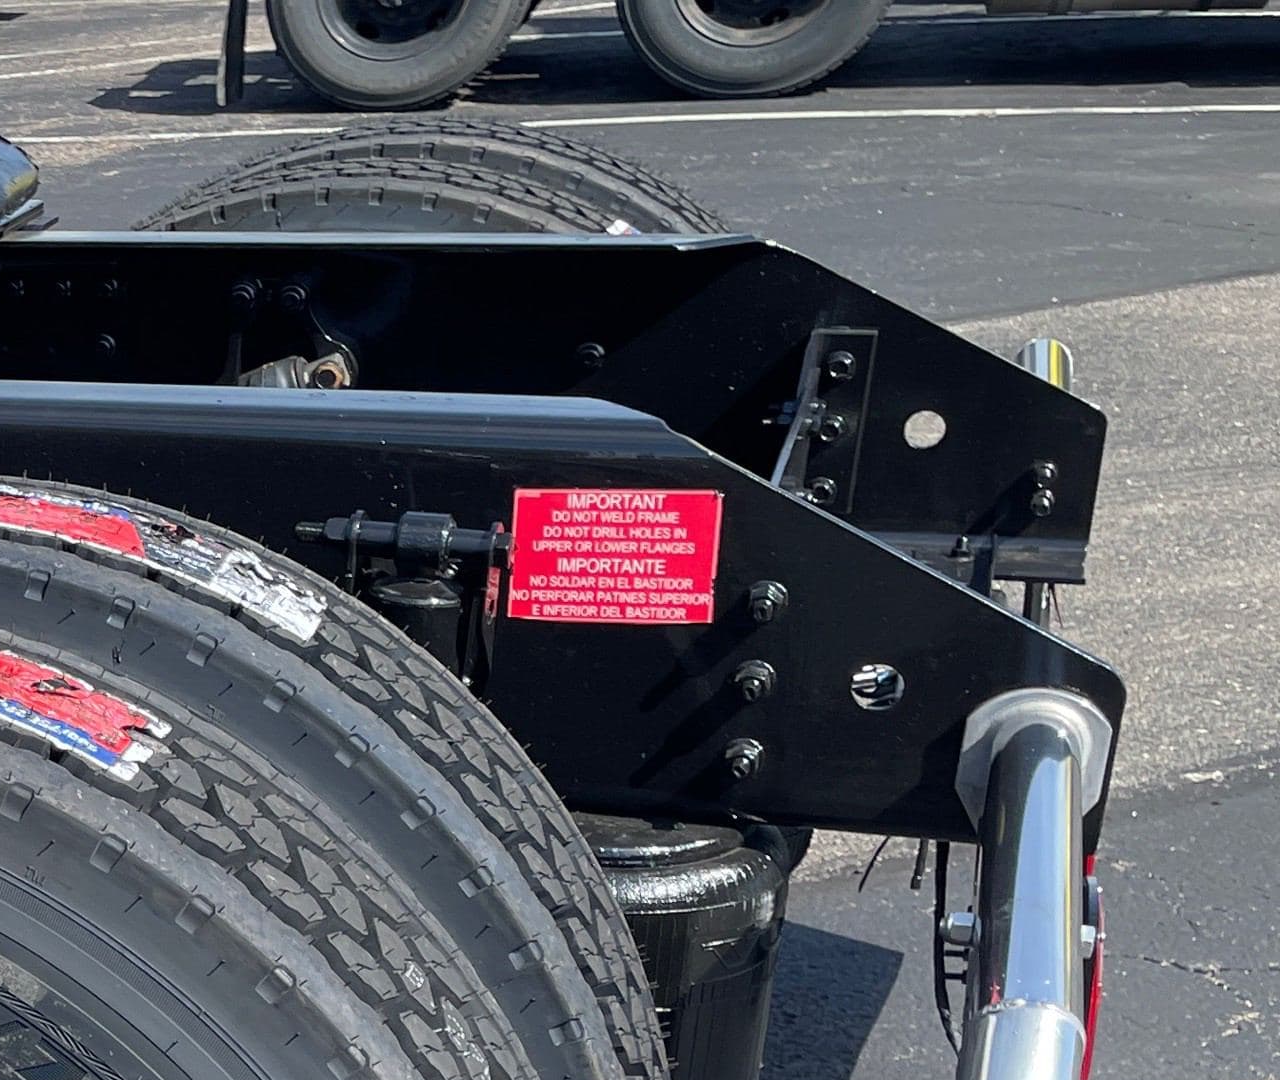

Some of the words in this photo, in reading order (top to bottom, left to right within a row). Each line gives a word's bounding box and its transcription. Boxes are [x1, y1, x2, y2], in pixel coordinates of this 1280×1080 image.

[567, 494, 666, 510] IMPORTANT
[552, 511, 570, 522] DO
[572, 512, 597, 522] NOT
[600, 512, 635, 523] WELD
[638, 512, 680, 524] FRAME
[543, 526, 562, 537] DO
[564, 527, 589, 538] NOT
[592, 527, 626, 538] DRILL
[630, 527, 671, 538] HOLES
[674, 528, 687, 539] IN
[533, 542, 572, 552] UPPER
[575, 542, 592, 552] OR
[595, 543, 637, 553] LOWER
[640, 543, 695, 554] FLANGES
[557, 558, 666, 575] IMPORTANTE
[530, 576, 547, 586] NO
[550, 577, 595, 587] SOLDAR
[599, 578, 614, 588] EN
[618, 578, 631, 588] EL
[635, 578, 693, 590] BASTIDOR
[513, 590, 529, 601] NO
[532, 590, 594, 602] PERFORAR
[597, 592, 646, 603] PATINES
[649, 593, 710, 605] SUPERIOR
[532, 605, 540, 615] E
[543, 606, 598, 617] INFERIOR
[602, 607, 623, 618] DEL
[626, 608, 686, 619] BASTIDOR
